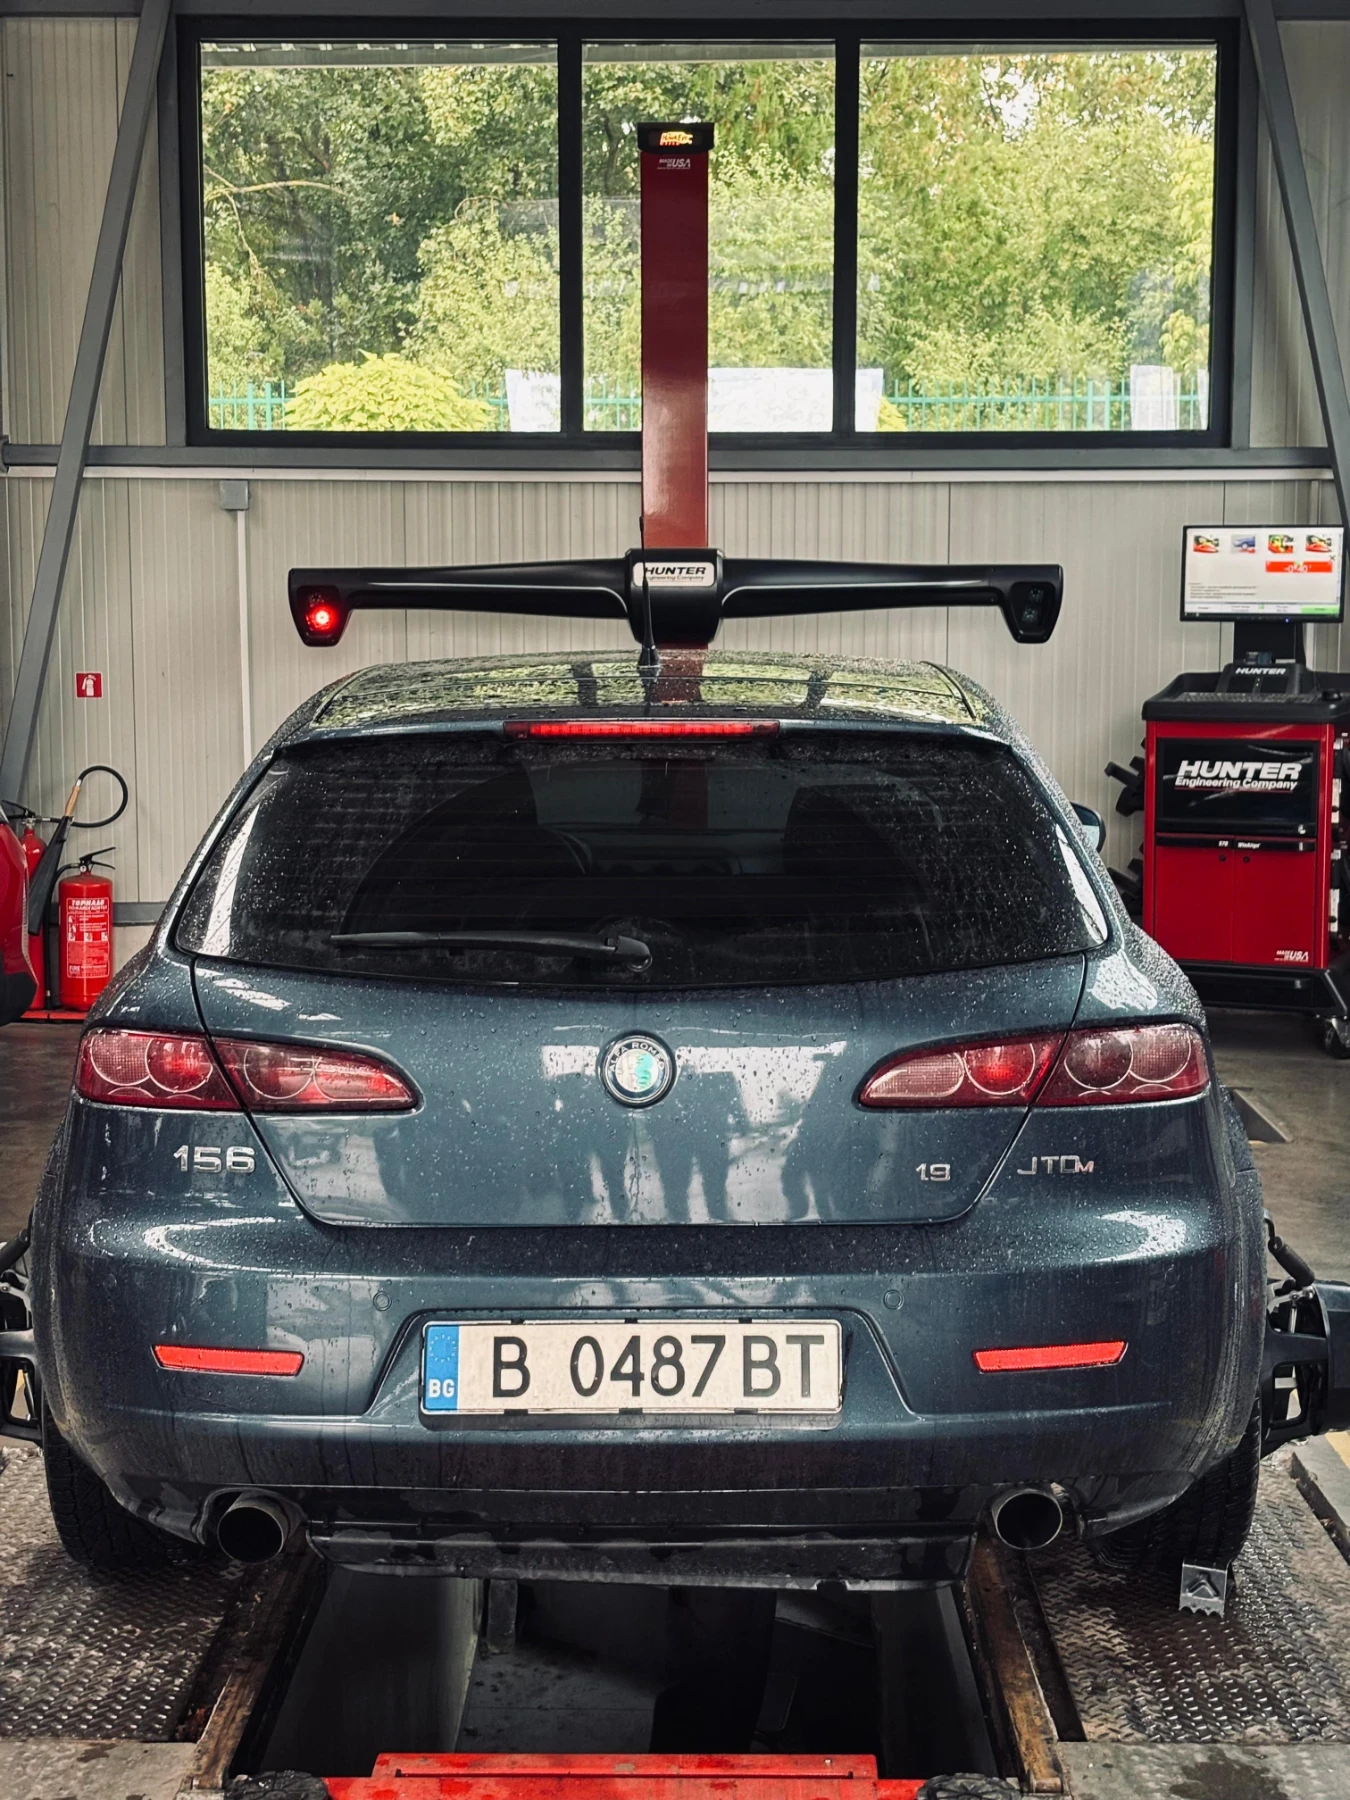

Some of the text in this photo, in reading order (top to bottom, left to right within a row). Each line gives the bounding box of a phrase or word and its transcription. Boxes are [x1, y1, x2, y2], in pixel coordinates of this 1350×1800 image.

[673, 159, 690, 167] USA
[644, 566, 706, 575] HUNTER
[1235, 667, 1286, 675] HUNTER
[1177, 760, 1302, 780] HUNTER
[1175, 777, 1298, 790] Engineering Company
[1289, 951, 1309, 962] USA
[173, 1145, 255, 1173] 156
[428, 1335, 825, 1398] BG B 0487 BT
